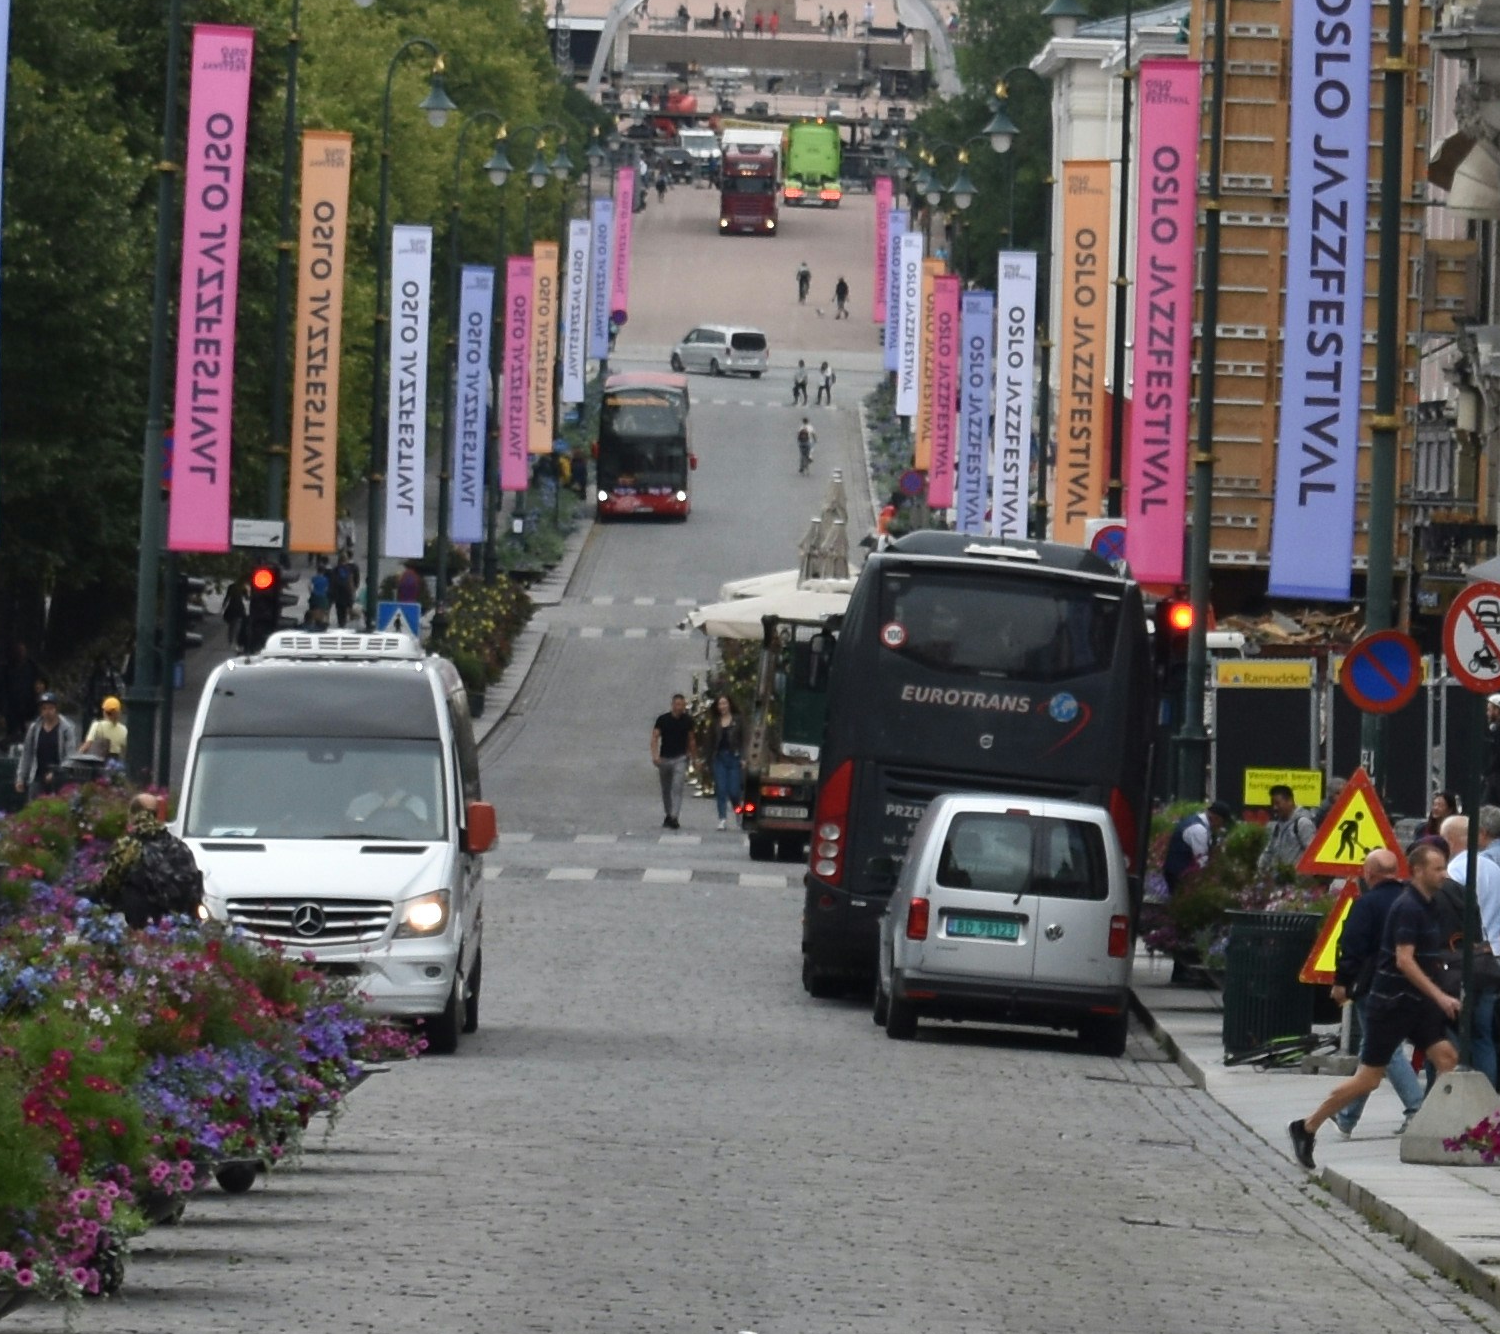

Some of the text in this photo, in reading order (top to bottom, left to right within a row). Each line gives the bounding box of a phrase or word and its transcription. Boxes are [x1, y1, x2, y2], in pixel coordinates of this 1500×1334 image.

[969, 335, 985, 388] OSLO
[1065, 227, 1097, 526] OSLO JAZZFESTIVAL
[1140, 145, 1181, 516] OSLO JAZZFESTIVAL
[1298, 132, 1351, 507] JAZZFESTIVAL
[964, 394, 983, 530] JAZZFESTIVAL
[1000, 306, 1026, 538] OSLO JAZZFESTIVAL
[901, 684, 1031, 714] EUROTRANS
[1244, 672, 1309, 684] Ramudden
